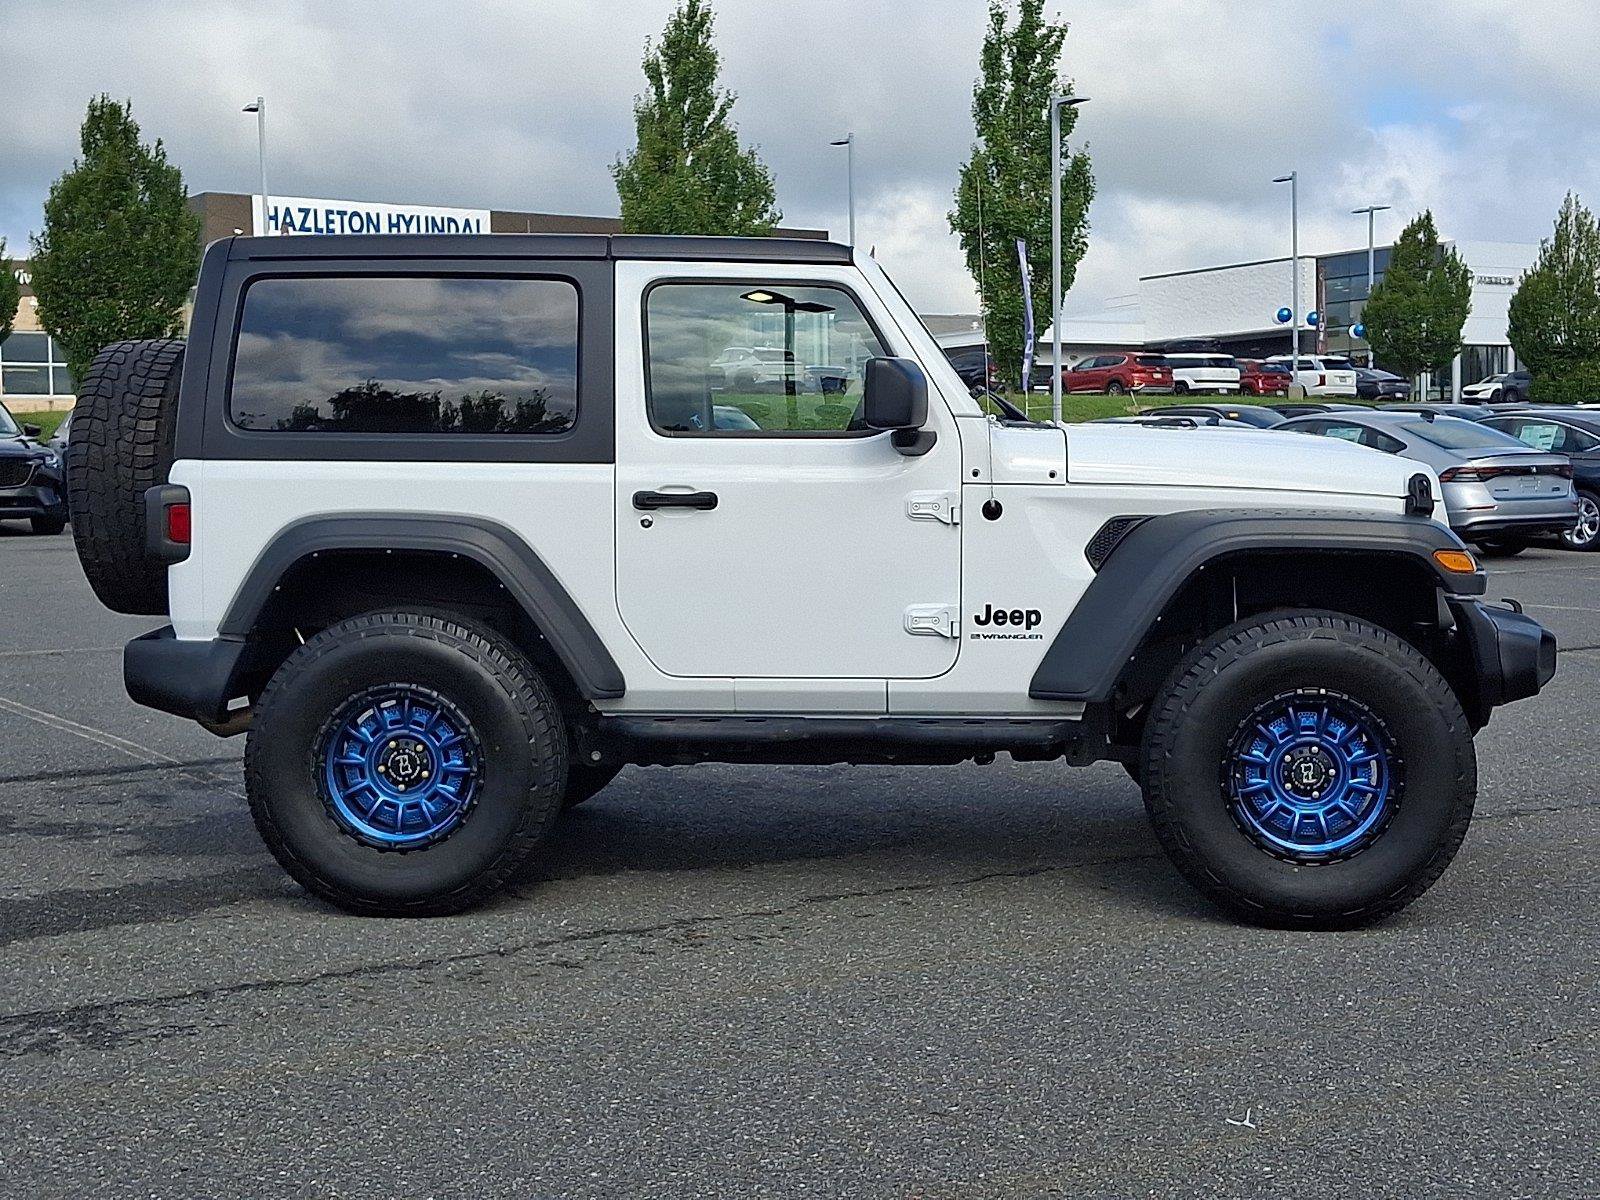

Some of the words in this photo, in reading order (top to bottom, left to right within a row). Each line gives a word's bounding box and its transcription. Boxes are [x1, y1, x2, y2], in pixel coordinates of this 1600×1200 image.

[268, 206, 380, 234] HAZLETON
[388, 213, 481, 234] HYUNDAI
[974, 604, 1041, 630] Jeep
